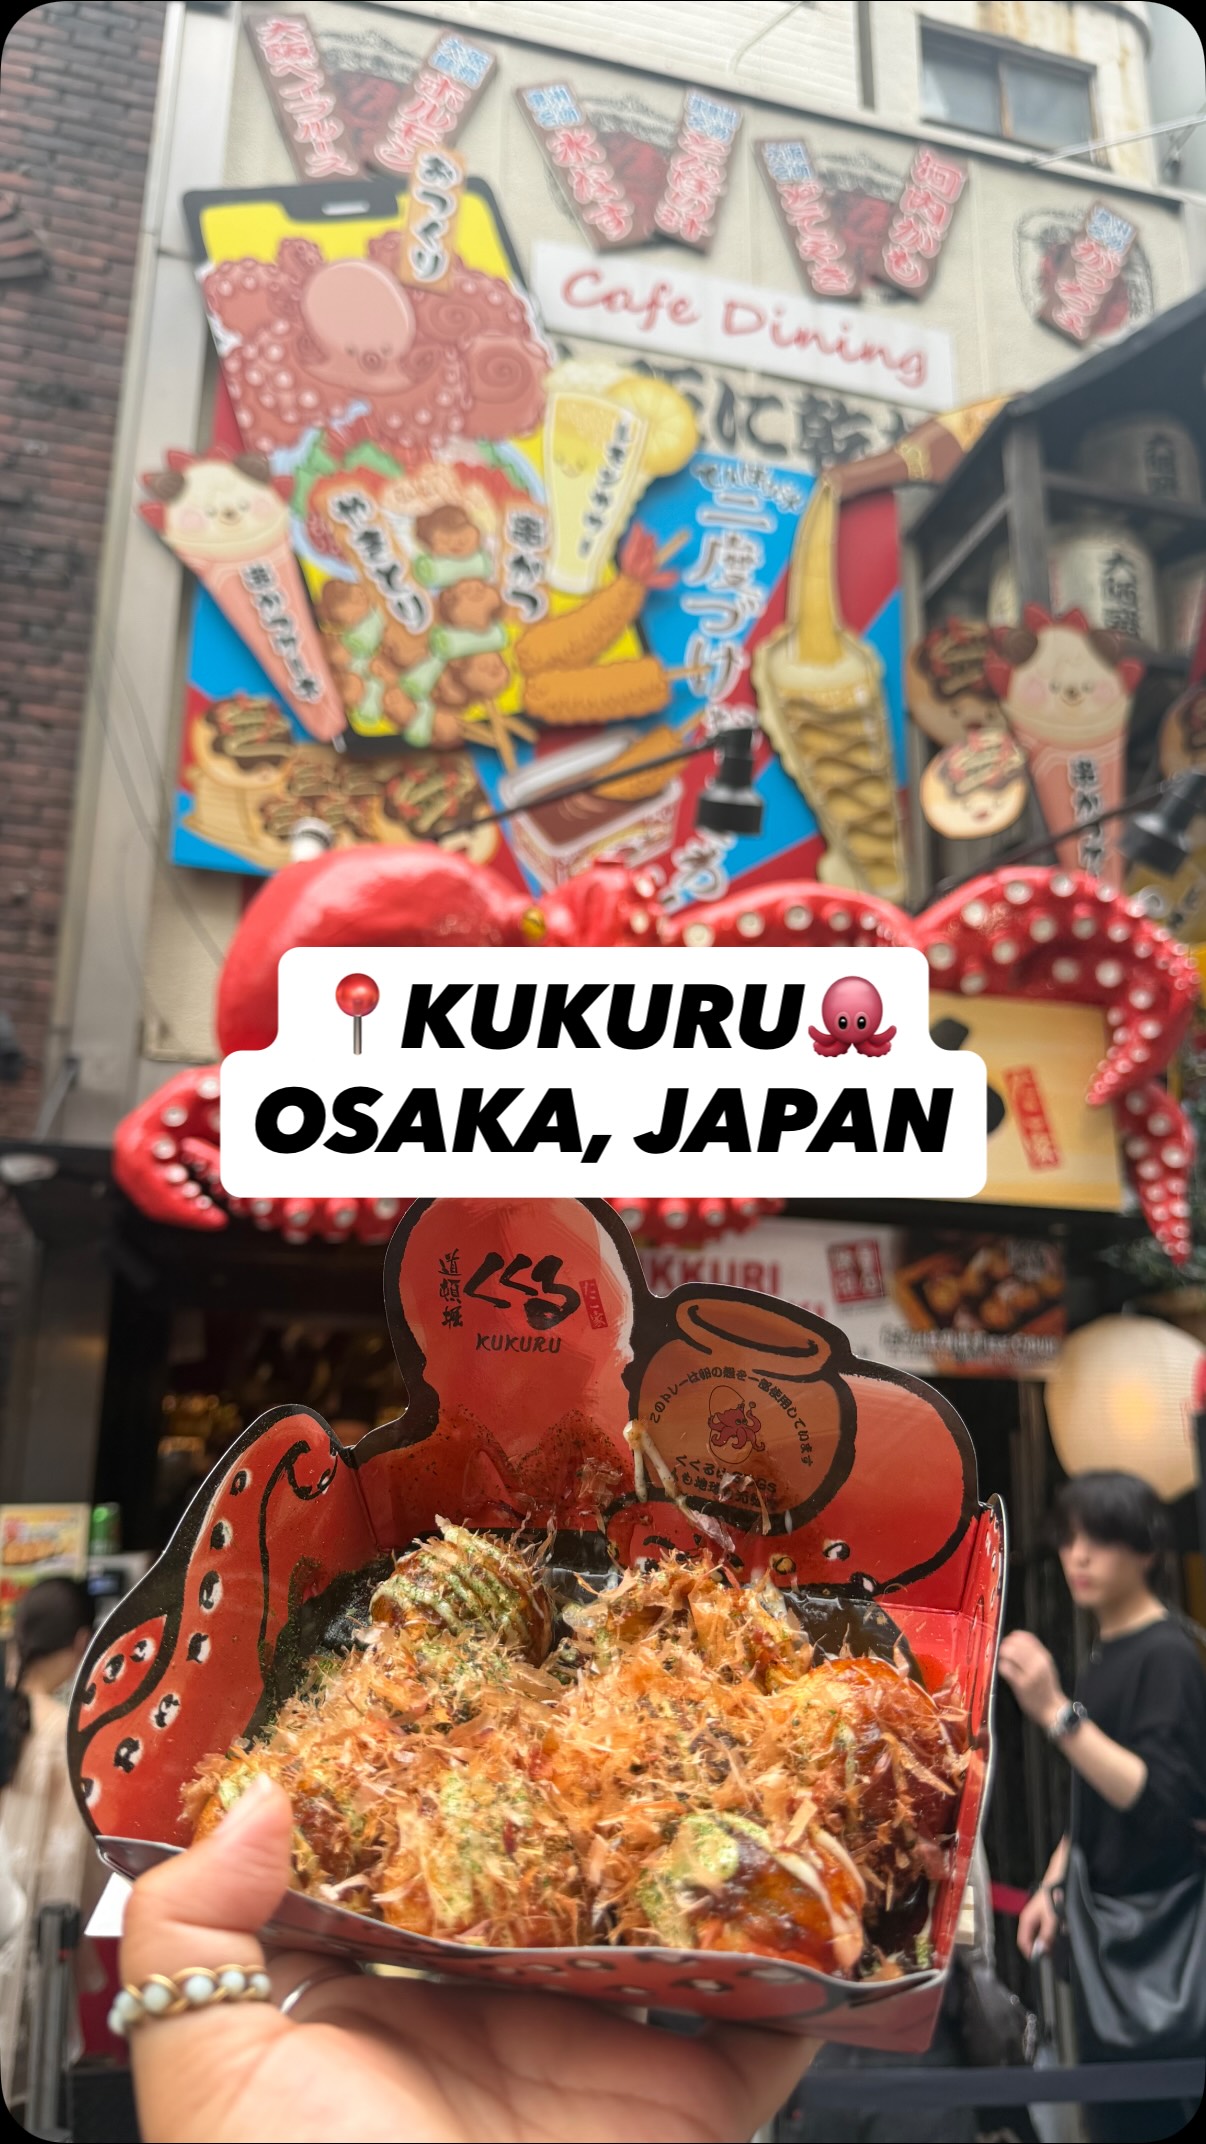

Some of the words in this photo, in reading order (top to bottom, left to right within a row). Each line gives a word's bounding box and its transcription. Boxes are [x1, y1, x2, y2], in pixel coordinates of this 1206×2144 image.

[562, 268, 699, 332] Cafe
[723, 299, 929, 388] Dining
[331, 493, 431, 633] やきとり
[505, 512, 548, 621] 串かつ
[438, 1248, 463, 1329] 道頓堀
[463, 1252, 581, 1330] くくる
[476, 1332, 562, 1354] KUKURU
